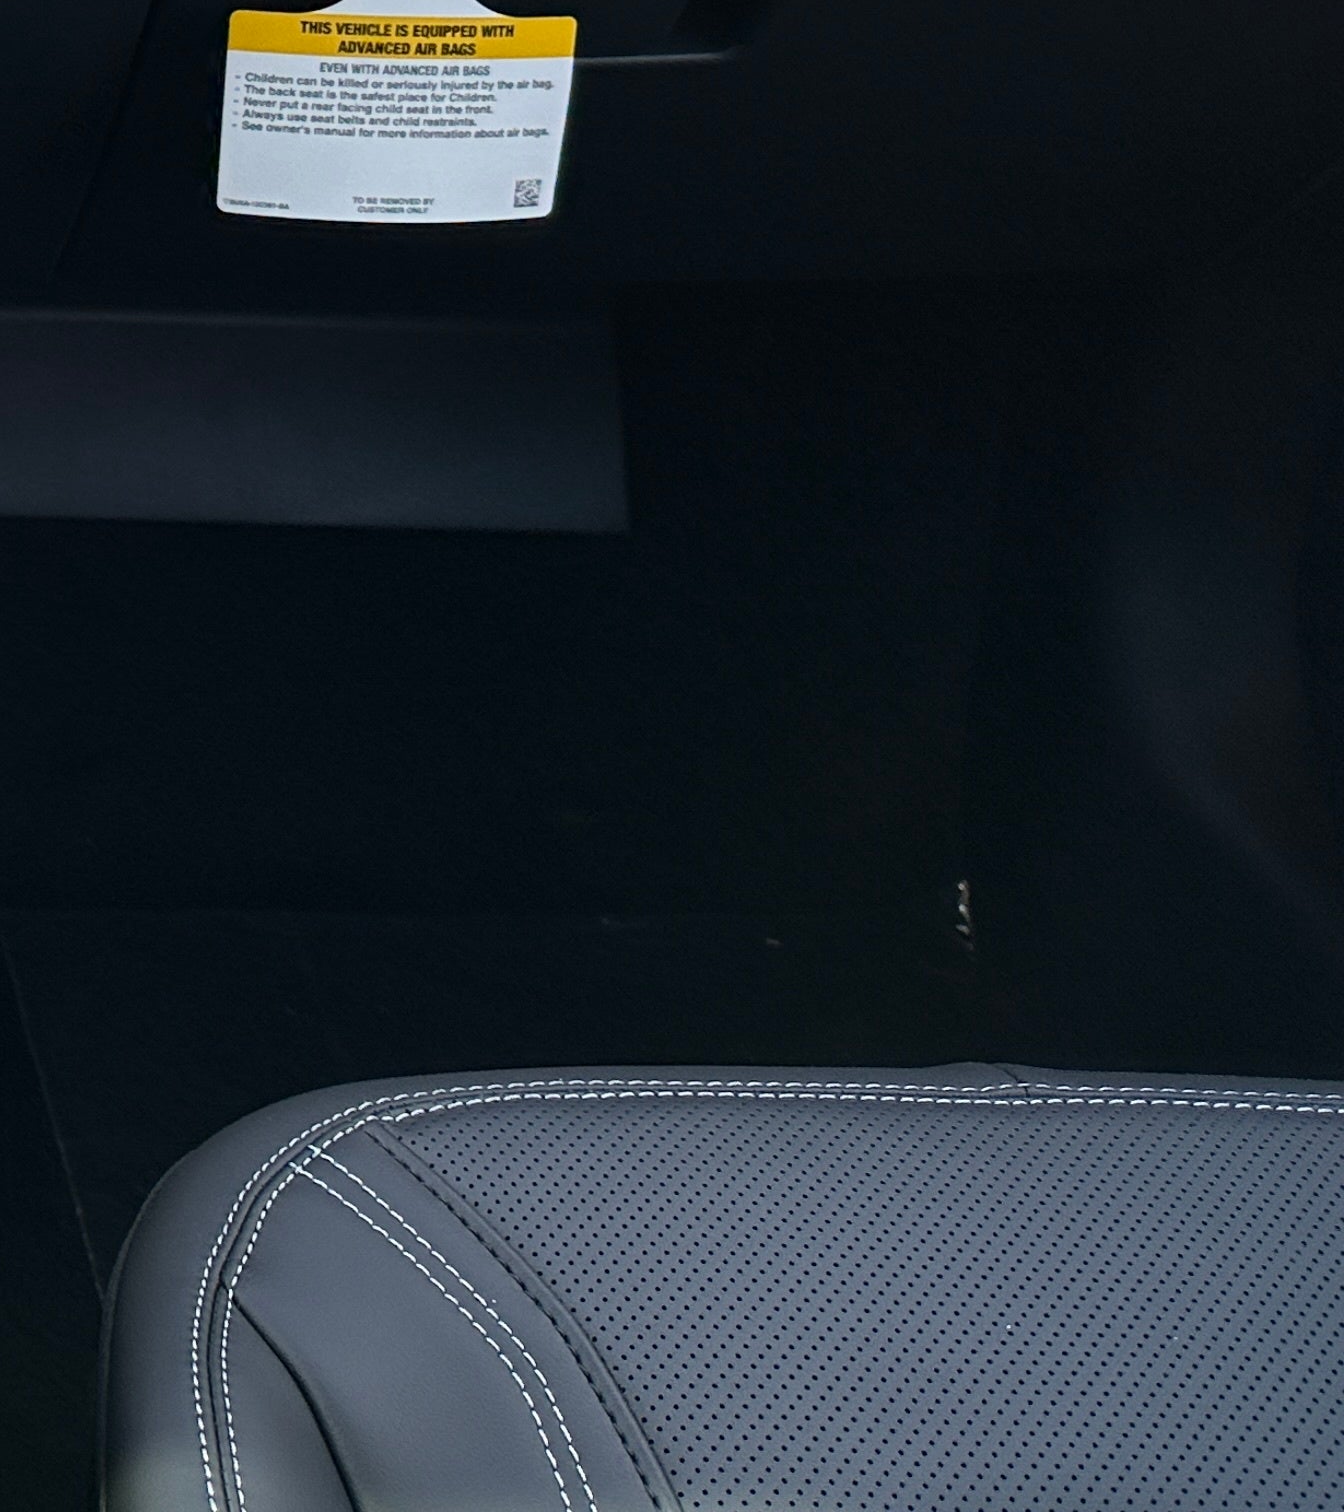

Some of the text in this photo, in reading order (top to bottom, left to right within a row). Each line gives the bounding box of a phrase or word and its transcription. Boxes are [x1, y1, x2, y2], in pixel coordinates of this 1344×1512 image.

[300, 20, 515, 38] THIS VEHICLE IS EQUIPPED WITH
[338, 40, 477, 56] ADVANCED AIR BAGS
[319, 61, 491, 76] EVEN WITH ADVANCED AIR BAGS
[244, 72, 554, 92] Children can be killed seriously injured by the bag.
[244, 84, 497, 103] The back seat the safest place for Children.
[243, 97, 494, 115] Never put rear facing child seat the front.
[242, 108, 284, 121] Always
[287, 113, 308, 122] use
[311, 114, 335, 123] seat
[338, 114, 366, 125] belts
[368, 116, 390, 126] and
[393, 116, 420, 127] child
[241, 120, 262, 131] See
[265, 124, 311, 135] owner's
[313, 127, 356, 137] manual
[358, 127, 375, 138] for
[377, 129, 407, 138] more
[409, 129, 472, 139] information
[474, 127, 505, 138] about
